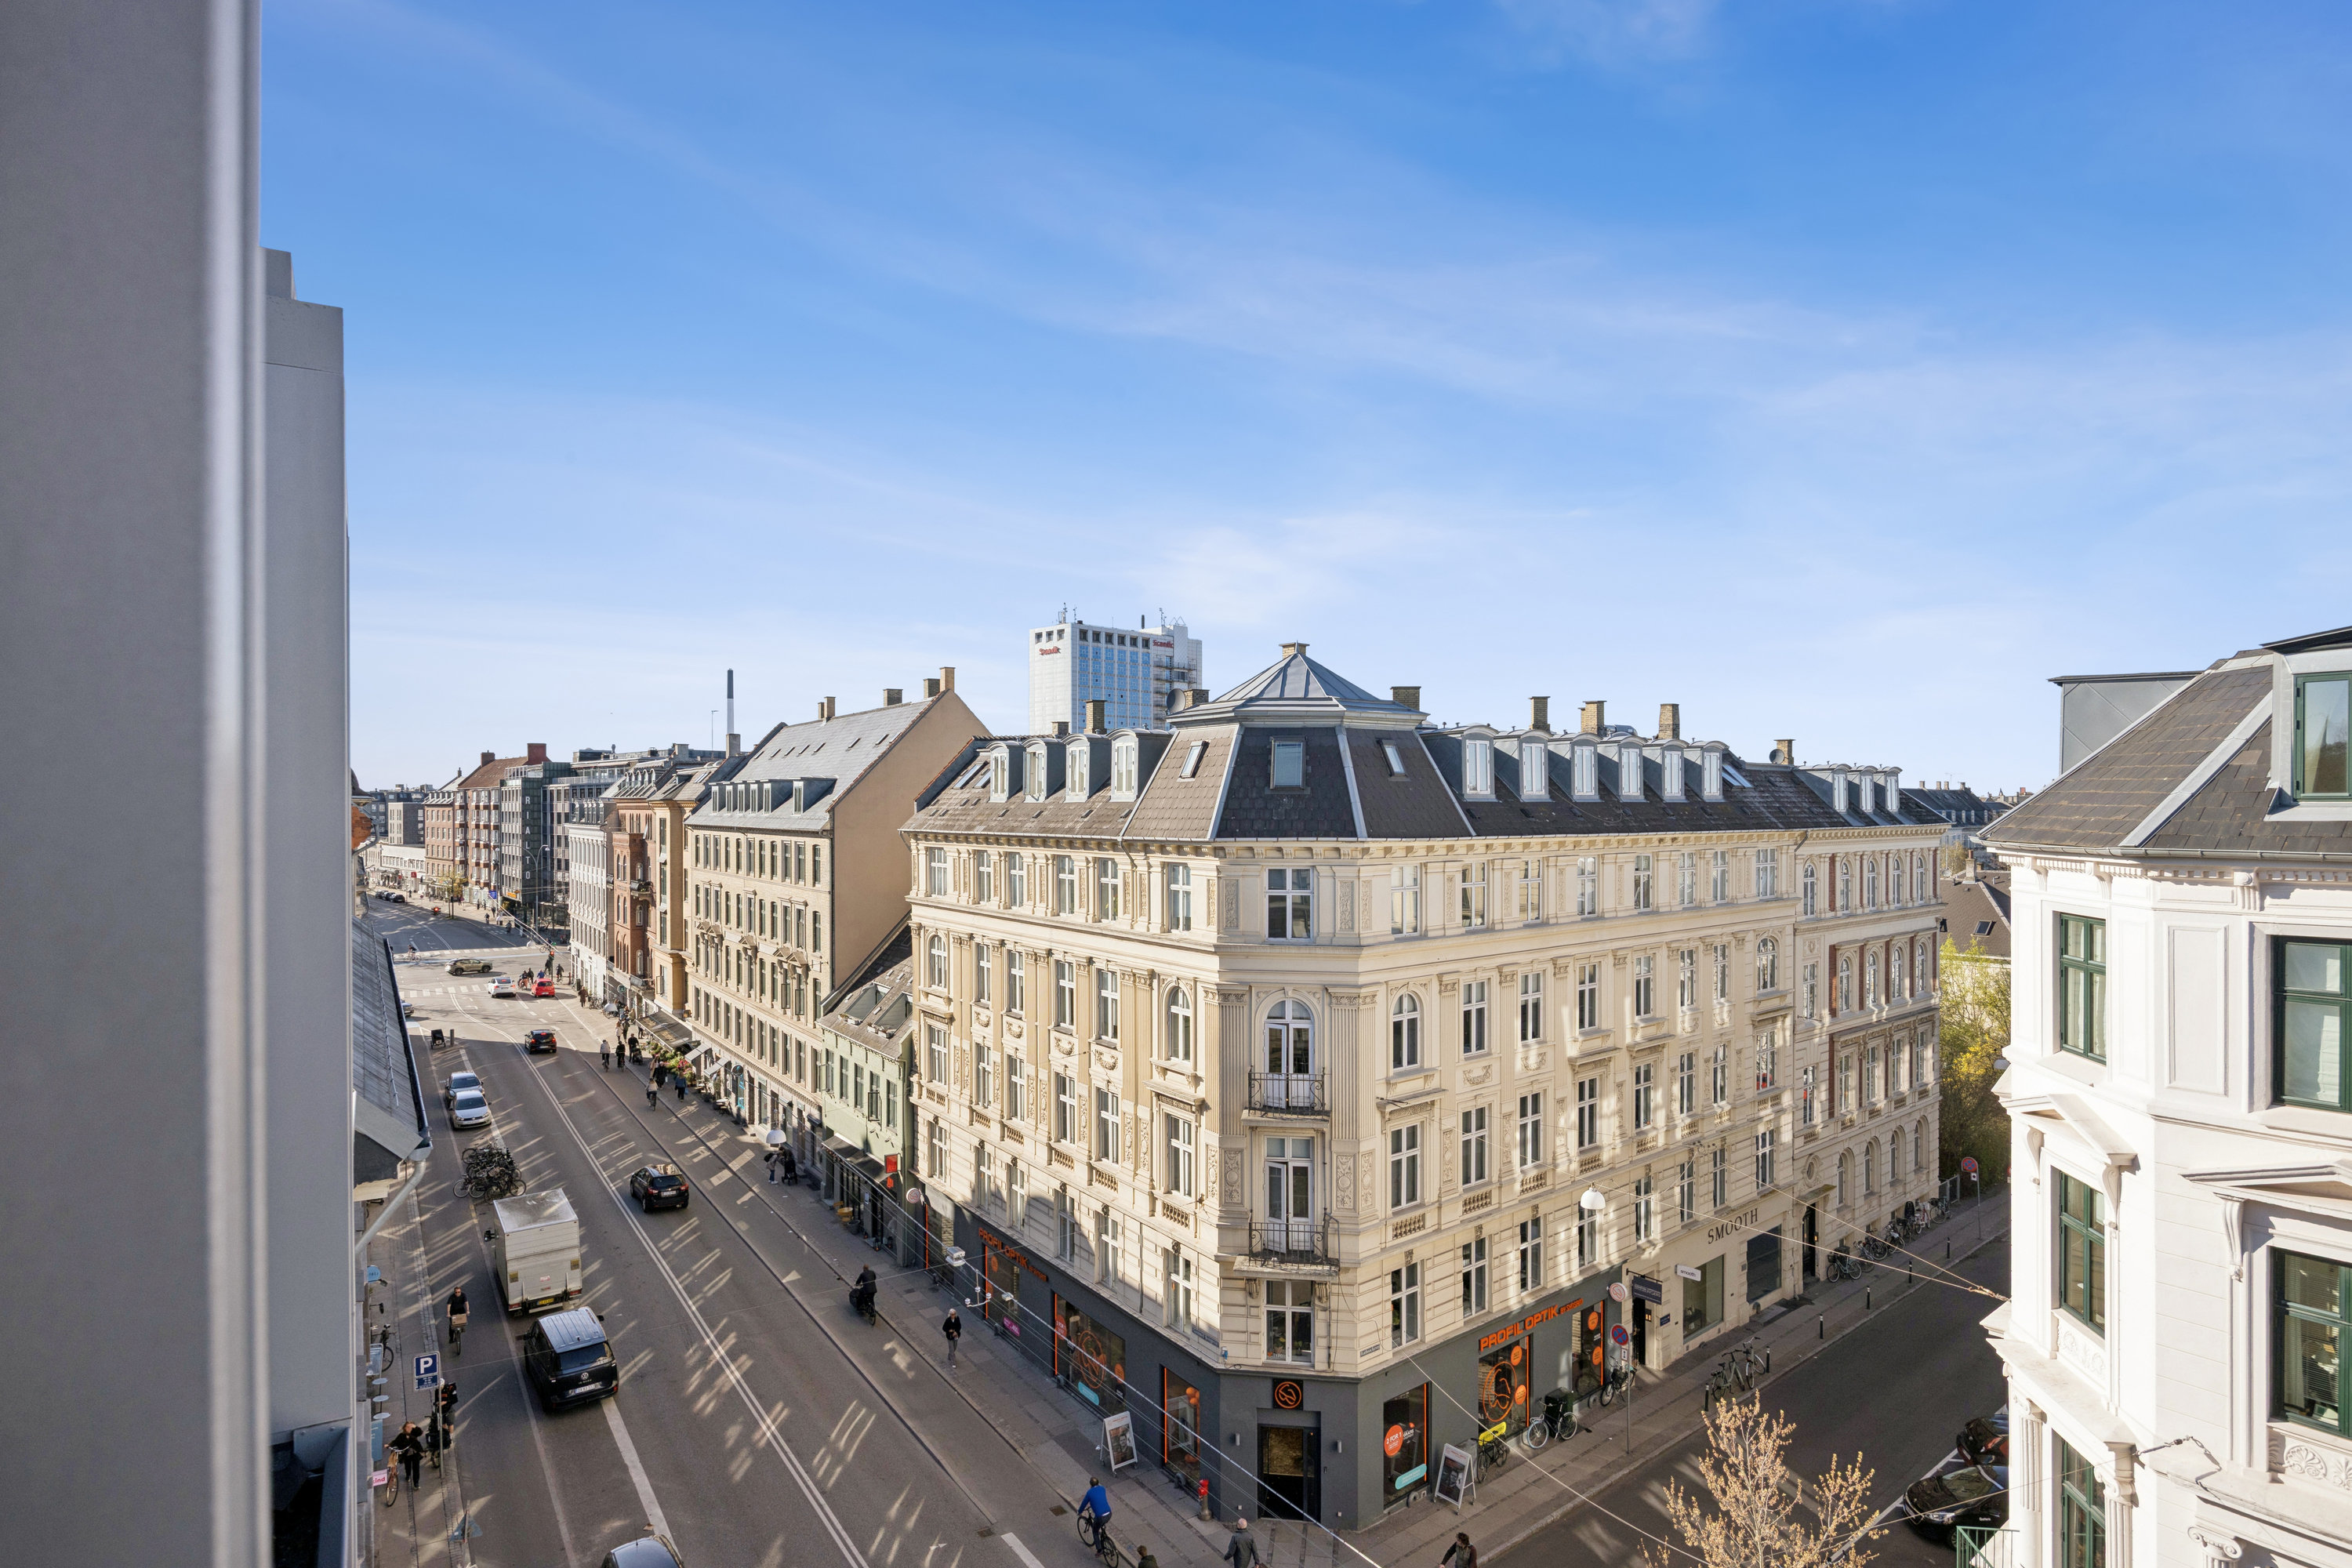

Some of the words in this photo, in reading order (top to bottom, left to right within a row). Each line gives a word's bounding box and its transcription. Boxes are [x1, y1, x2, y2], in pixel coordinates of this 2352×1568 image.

[1152, 639, 1174, 648] Scandic
[1708, 1207, 1759, 1244] SMOOTH
[978, 1227, 1004, 1253] PROFIL
[1004, 1245, 1029, 1269] OPTIK
[1479, 1321, 1523, 1352] PROFIL
[1524, 1305, 1559, 1330] OPTIK
[419, 1357, 433, 1374] P
[1389, 1433, 1399, 1442] FOR
